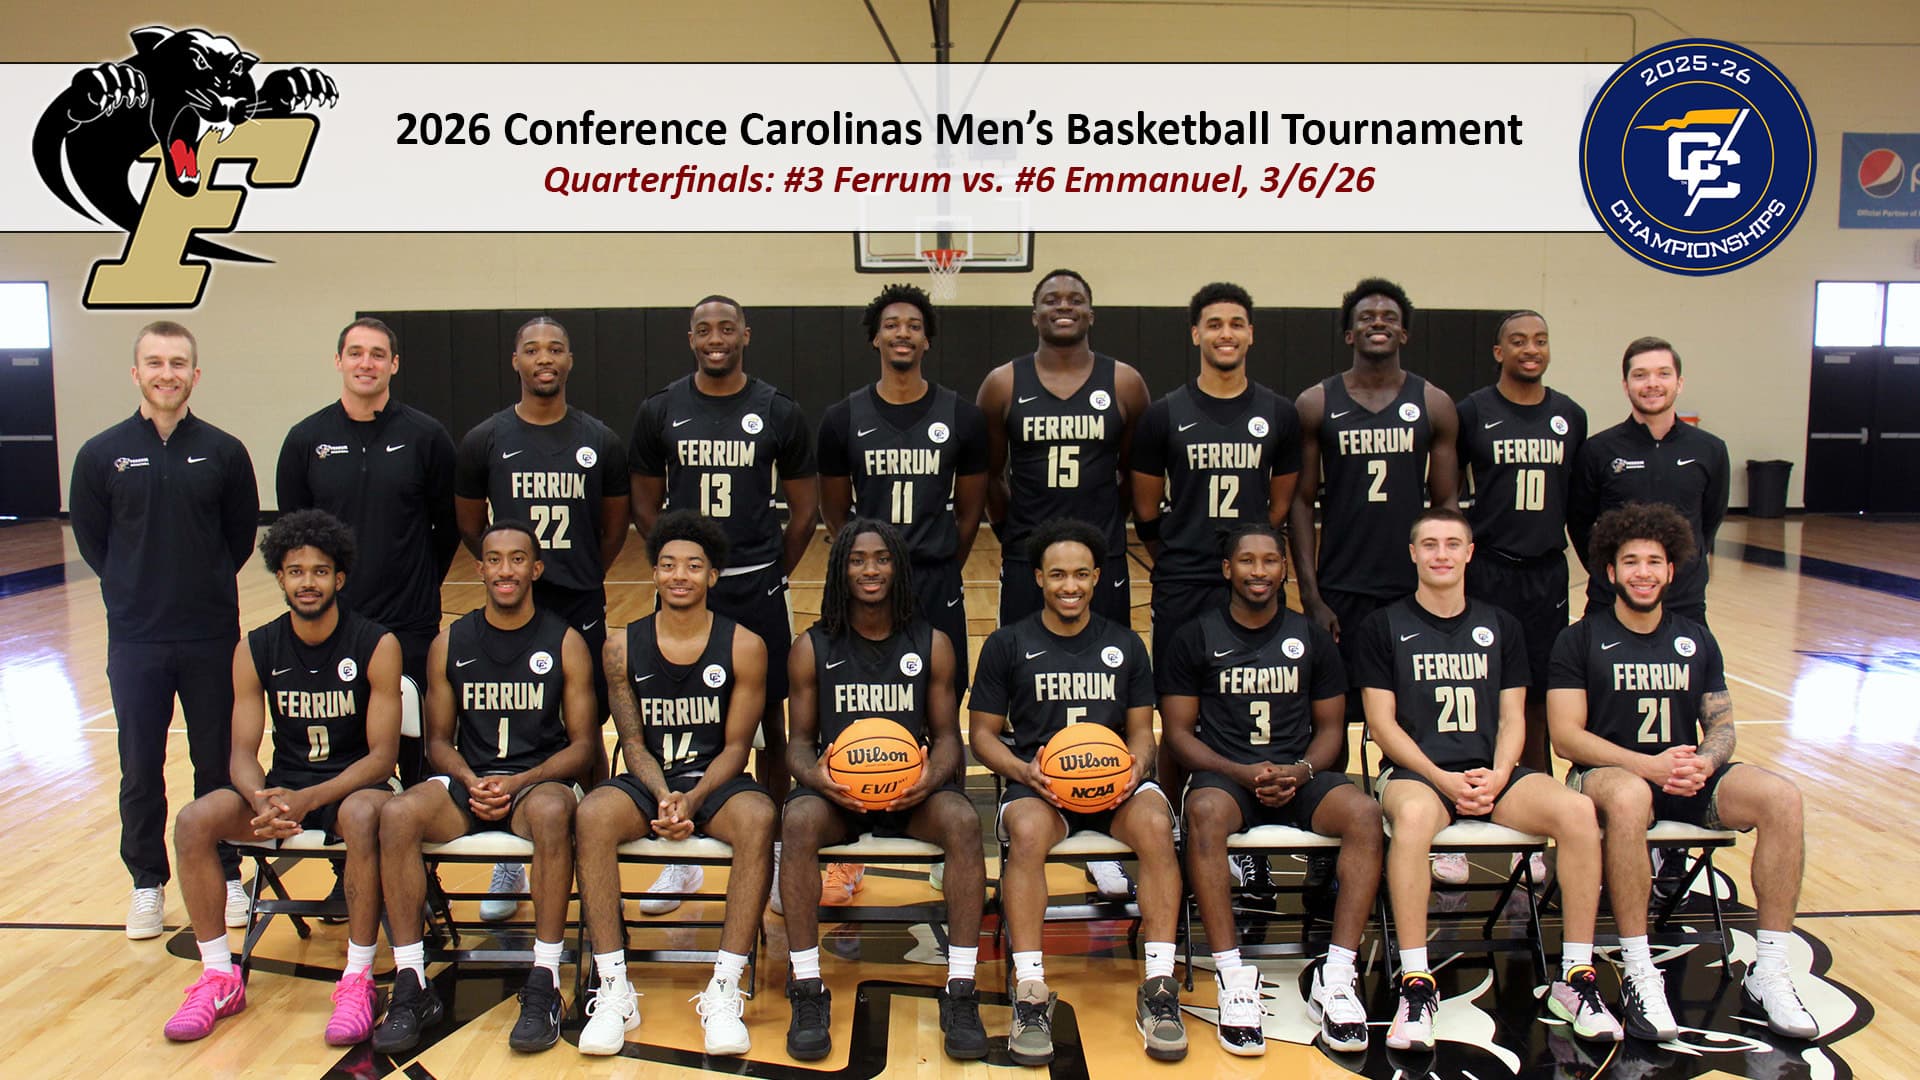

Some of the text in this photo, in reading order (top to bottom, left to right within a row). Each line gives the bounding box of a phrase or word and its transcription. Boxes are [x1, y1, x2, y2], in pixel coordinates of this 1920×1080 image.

[1023, 415, 1105, 442] FERRUM
[1338, 427, 1415, 455] FERRUM
[678, 440, 756, 467] FERRUM
[864, 448, 941, 476] FERRUM
[1186, 442, 1263, 470] FERRUM
[1492, 438, 1565, 465] FERRUM
[1047, 446, 1080, 488] 15
[1367, 459, 1388, 502] 2
[511, 472, 586, 499] FERRUM
[700, 473, 732, 518] 13
[1208, 475, 1240, 518] 12
[1515, 469, 1546, 511] 10
[891, 481, 914, 524] 11
[530, 505, 571, 549] 22
[1220, 666, 1299, 694] FERRUM
[1412, 653, 1489, 681] FERRUM
[1613, 663, 1690, 691] FERRUM
[463, 682, 545, 710] FERRUM
[834, 683, 915, 713] FERRUM
[1034, 672, 1117, 702] FERRUM
[276, 689, 357, 719] FERRUM
[640, 695, 720, 727] FERRUM
[1435, 686, 1477, 733] 20
[1249, 701, 1271, 745] 3
[1637, 697, 1672, 743] 21
[307, 725, 331, 762] 0
[497, 717, 510, 759] 1
[846, 746, 909, 766] Wilson
[1058, 752, 1121, 772] Wilson
[1071, 782, 1115, 799] NCAA
